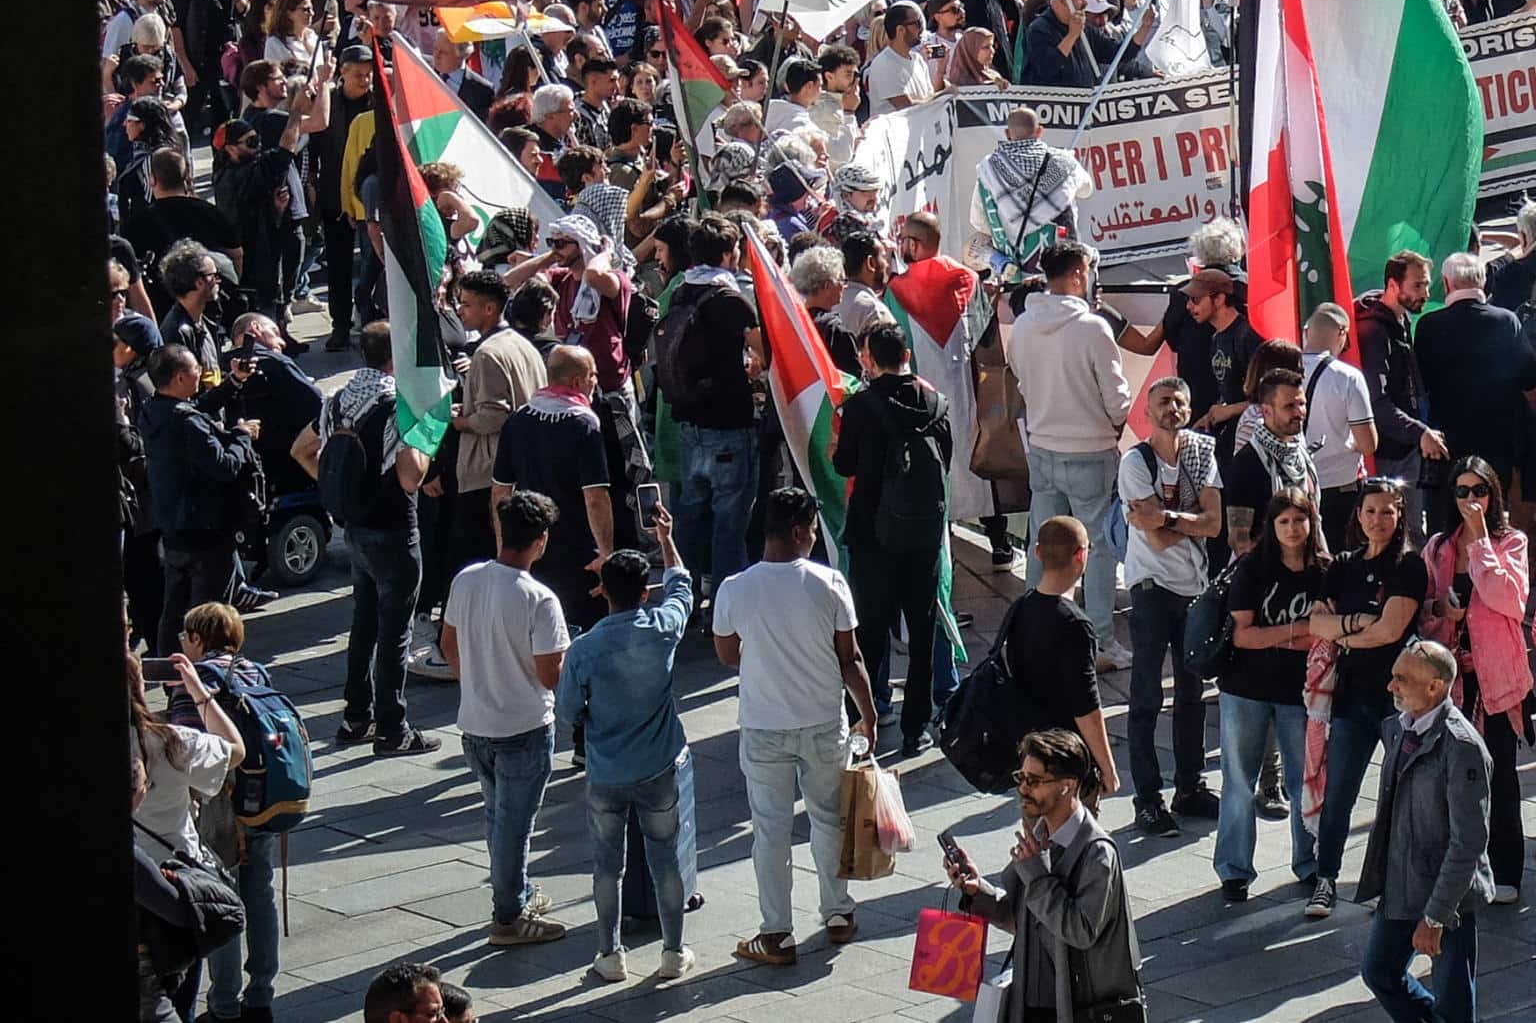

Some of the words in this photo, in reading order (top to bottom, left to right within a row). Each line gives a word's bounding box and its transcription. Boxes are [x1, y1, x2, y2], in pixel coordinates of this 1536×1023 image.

[986, 102, 1081, 126] MONI
[1090, 93, 1180, 123] NISTA
[1183, 82, 1238, 111] SE
[1152, 136, 1169, 181] I
